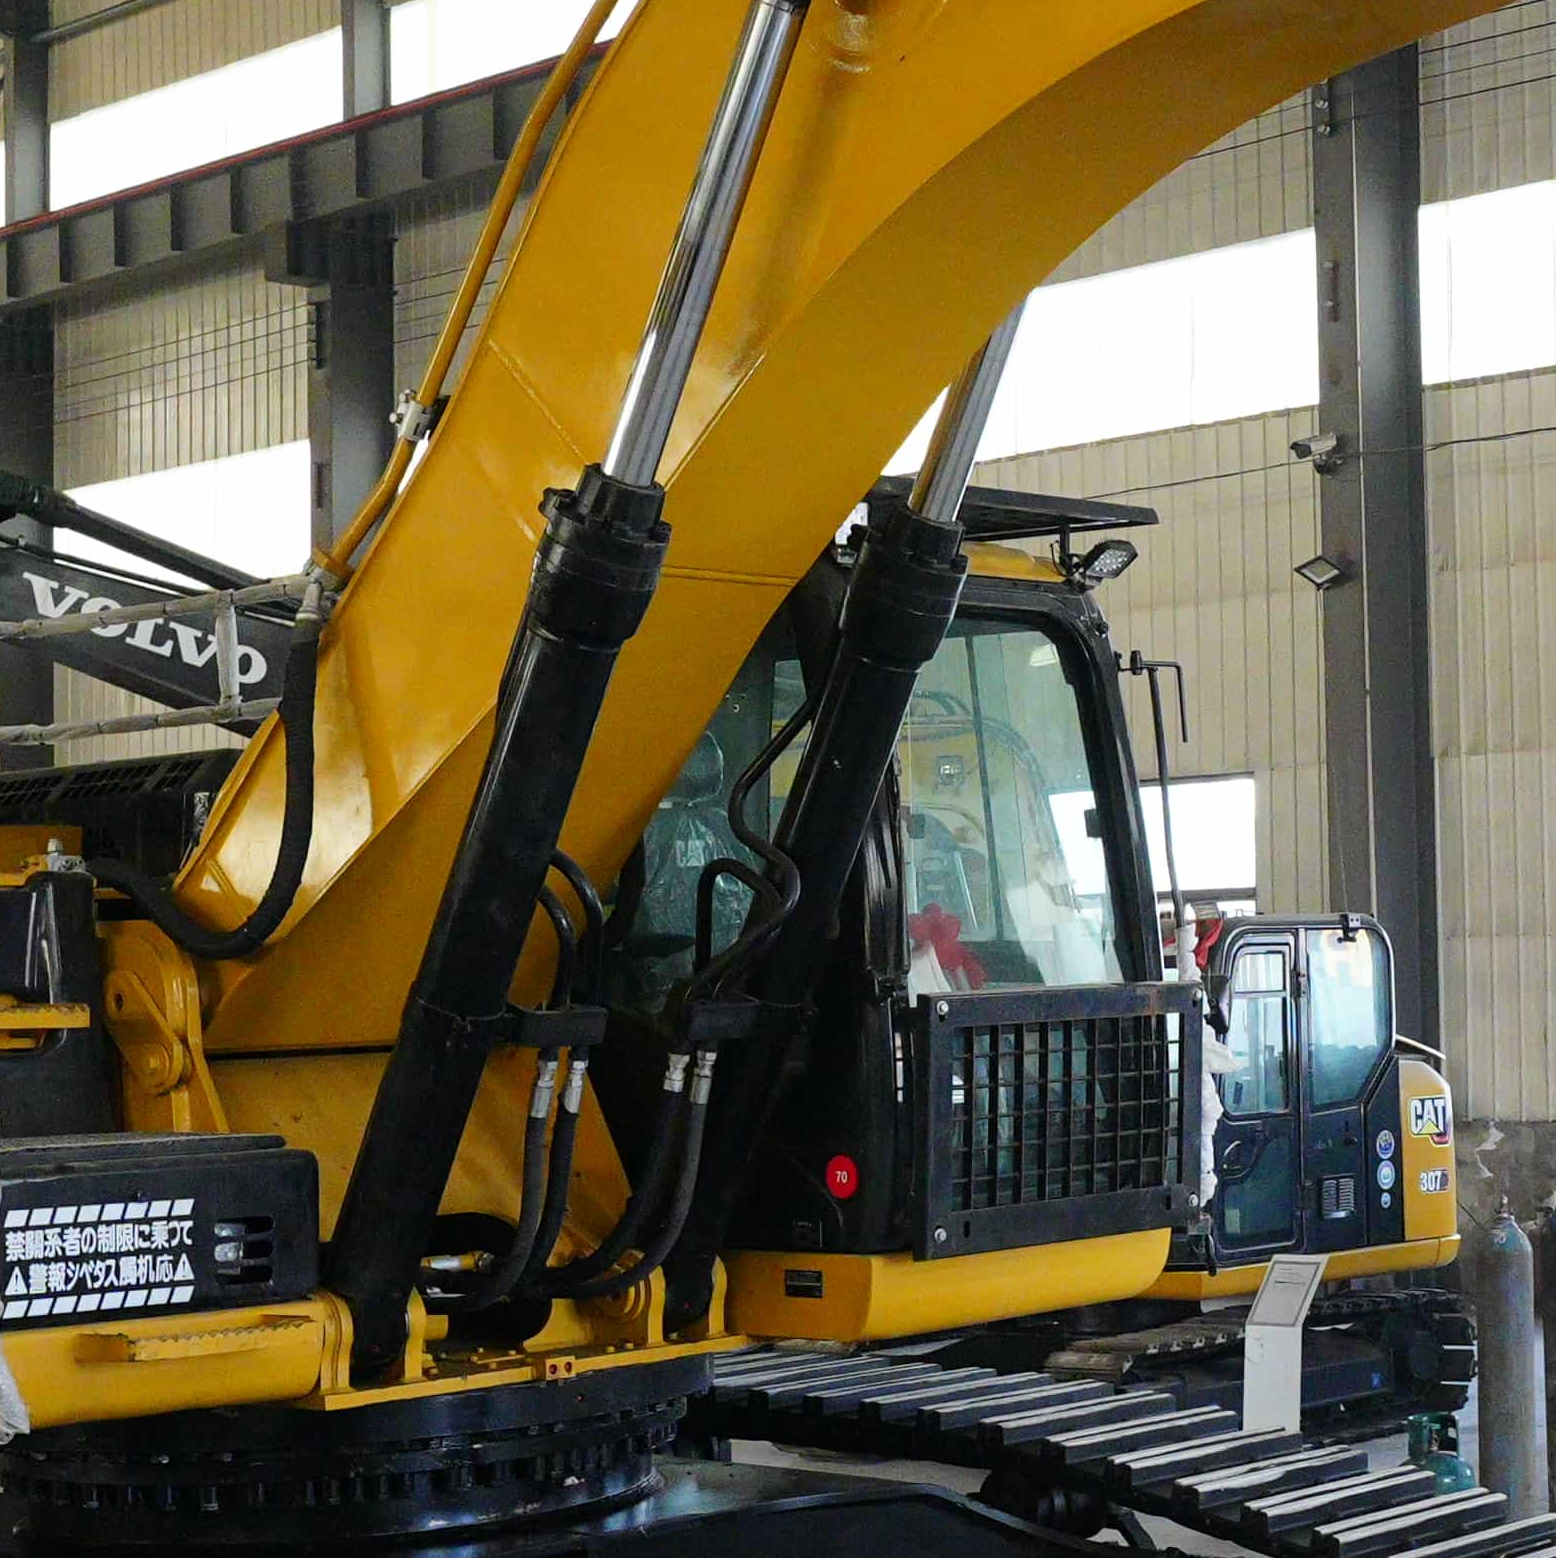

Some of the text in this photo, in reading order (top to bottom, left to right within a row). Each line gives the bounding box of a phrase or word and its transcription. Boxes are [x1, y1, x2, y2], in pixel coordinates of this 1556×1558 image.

[22, 572, 268, 685] VOLVO
[1410, 1098, 1446, 1135] CAT
[835, 1170, 848, 1184] 70
